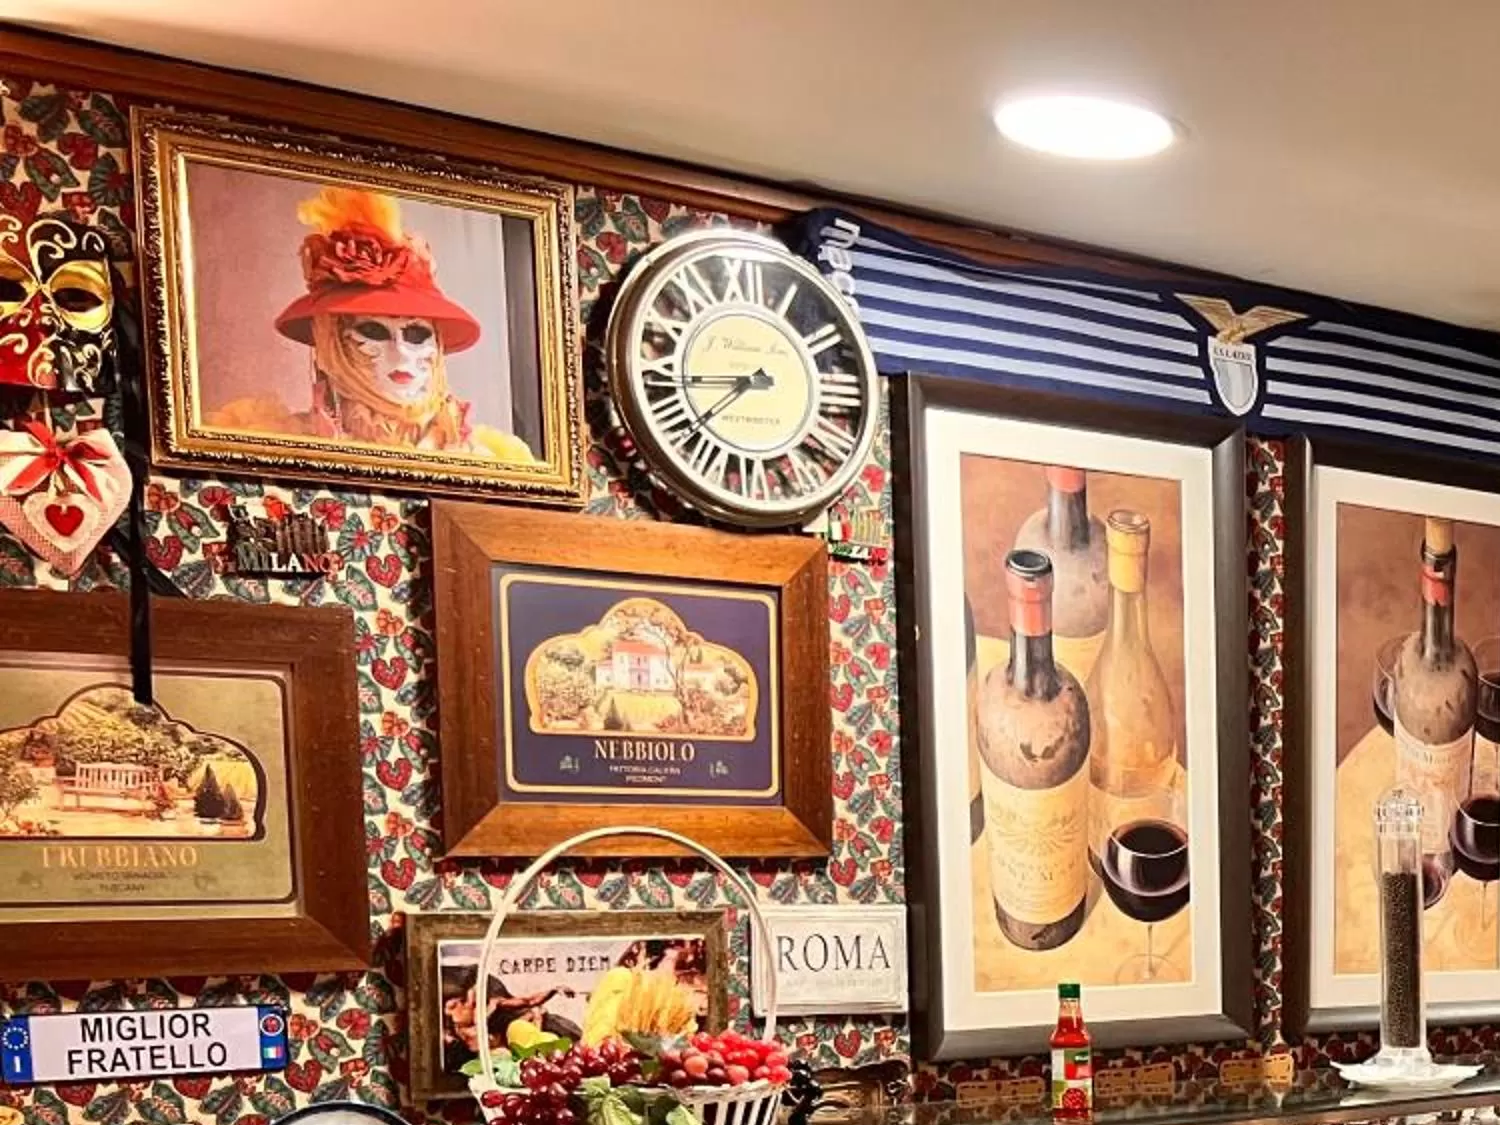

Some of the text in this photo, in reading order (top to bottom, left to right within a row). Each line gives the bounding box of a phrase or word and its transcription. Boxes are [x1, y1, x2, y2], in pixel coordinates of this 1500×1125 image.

[594, 739, 695, 762] NEBBIOLO
[500, 956, 611, 975] CARPE DIEM
[776, 933, 891, 972] ROMA
[80, 1013, 211, 1042] MIGLIOR
[67, 1042, 228, 1074] FRATELLO
